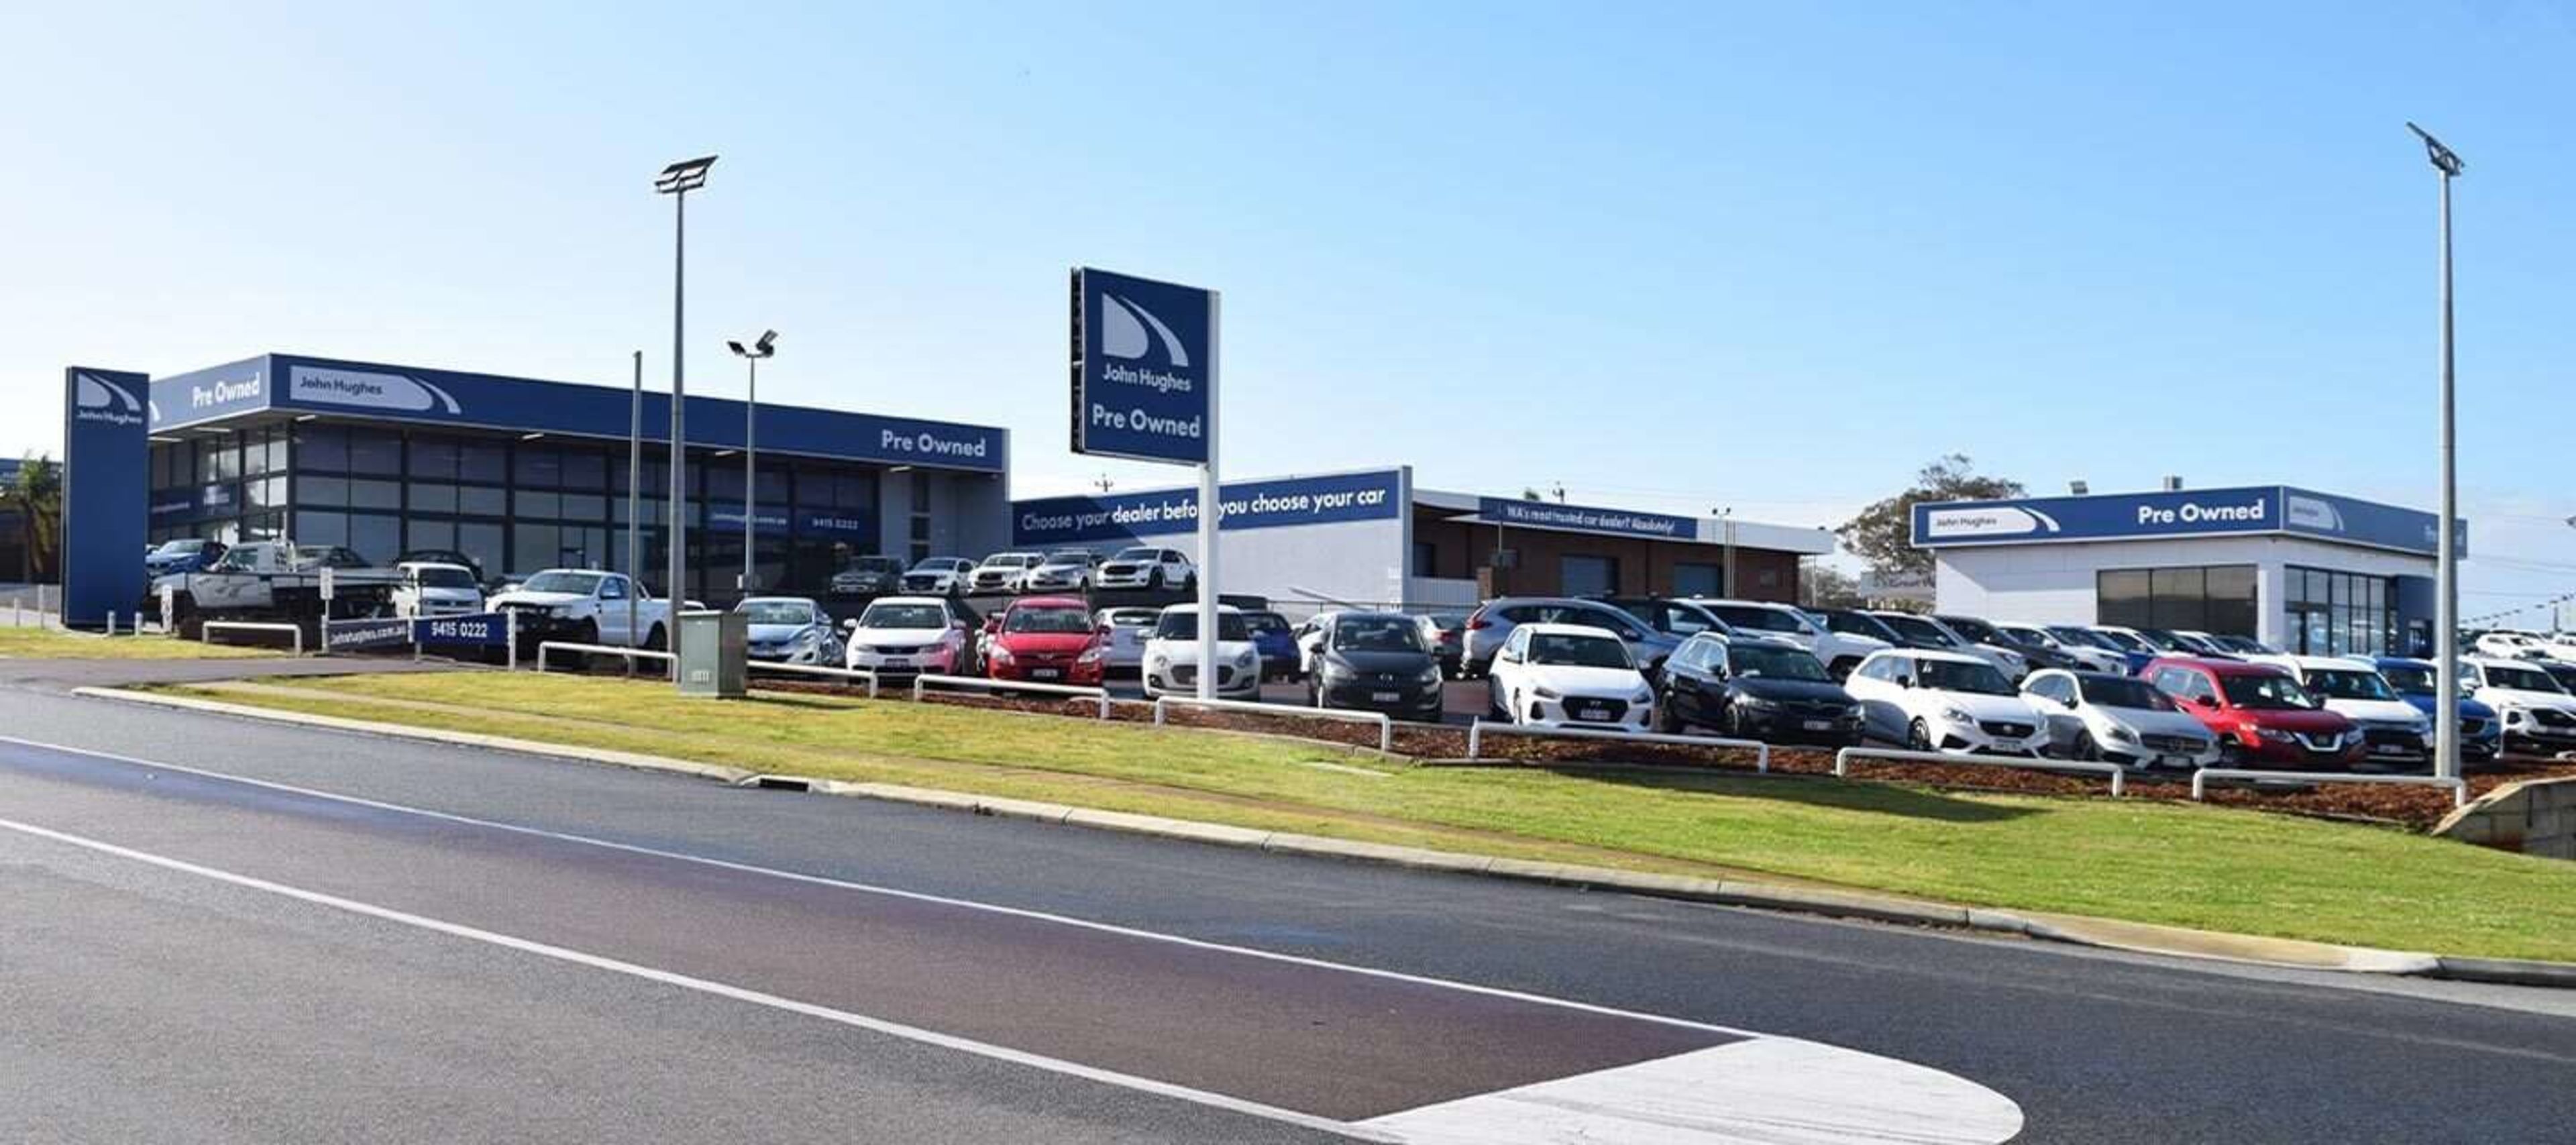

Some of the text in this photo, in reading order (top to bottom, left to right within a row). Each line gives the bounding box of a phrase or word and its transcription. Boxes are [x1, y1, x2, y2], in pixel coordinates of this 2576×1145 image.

[193, 371, 260, 408] Pre Owned
[300, 376, 382, 396] John Hughes
[1102, 363, 1191, 393] John Hughes
[1092, 403, 1200, 437] Pre Owned
[881, 429, 986, 457] Pre Owned
[1022, 489, 1386, 531] Choose your dealer befo you choose your car
[2138, 498, 2265, 525] Pre Owned
[431, 622, 488, 638] 9415 0222
